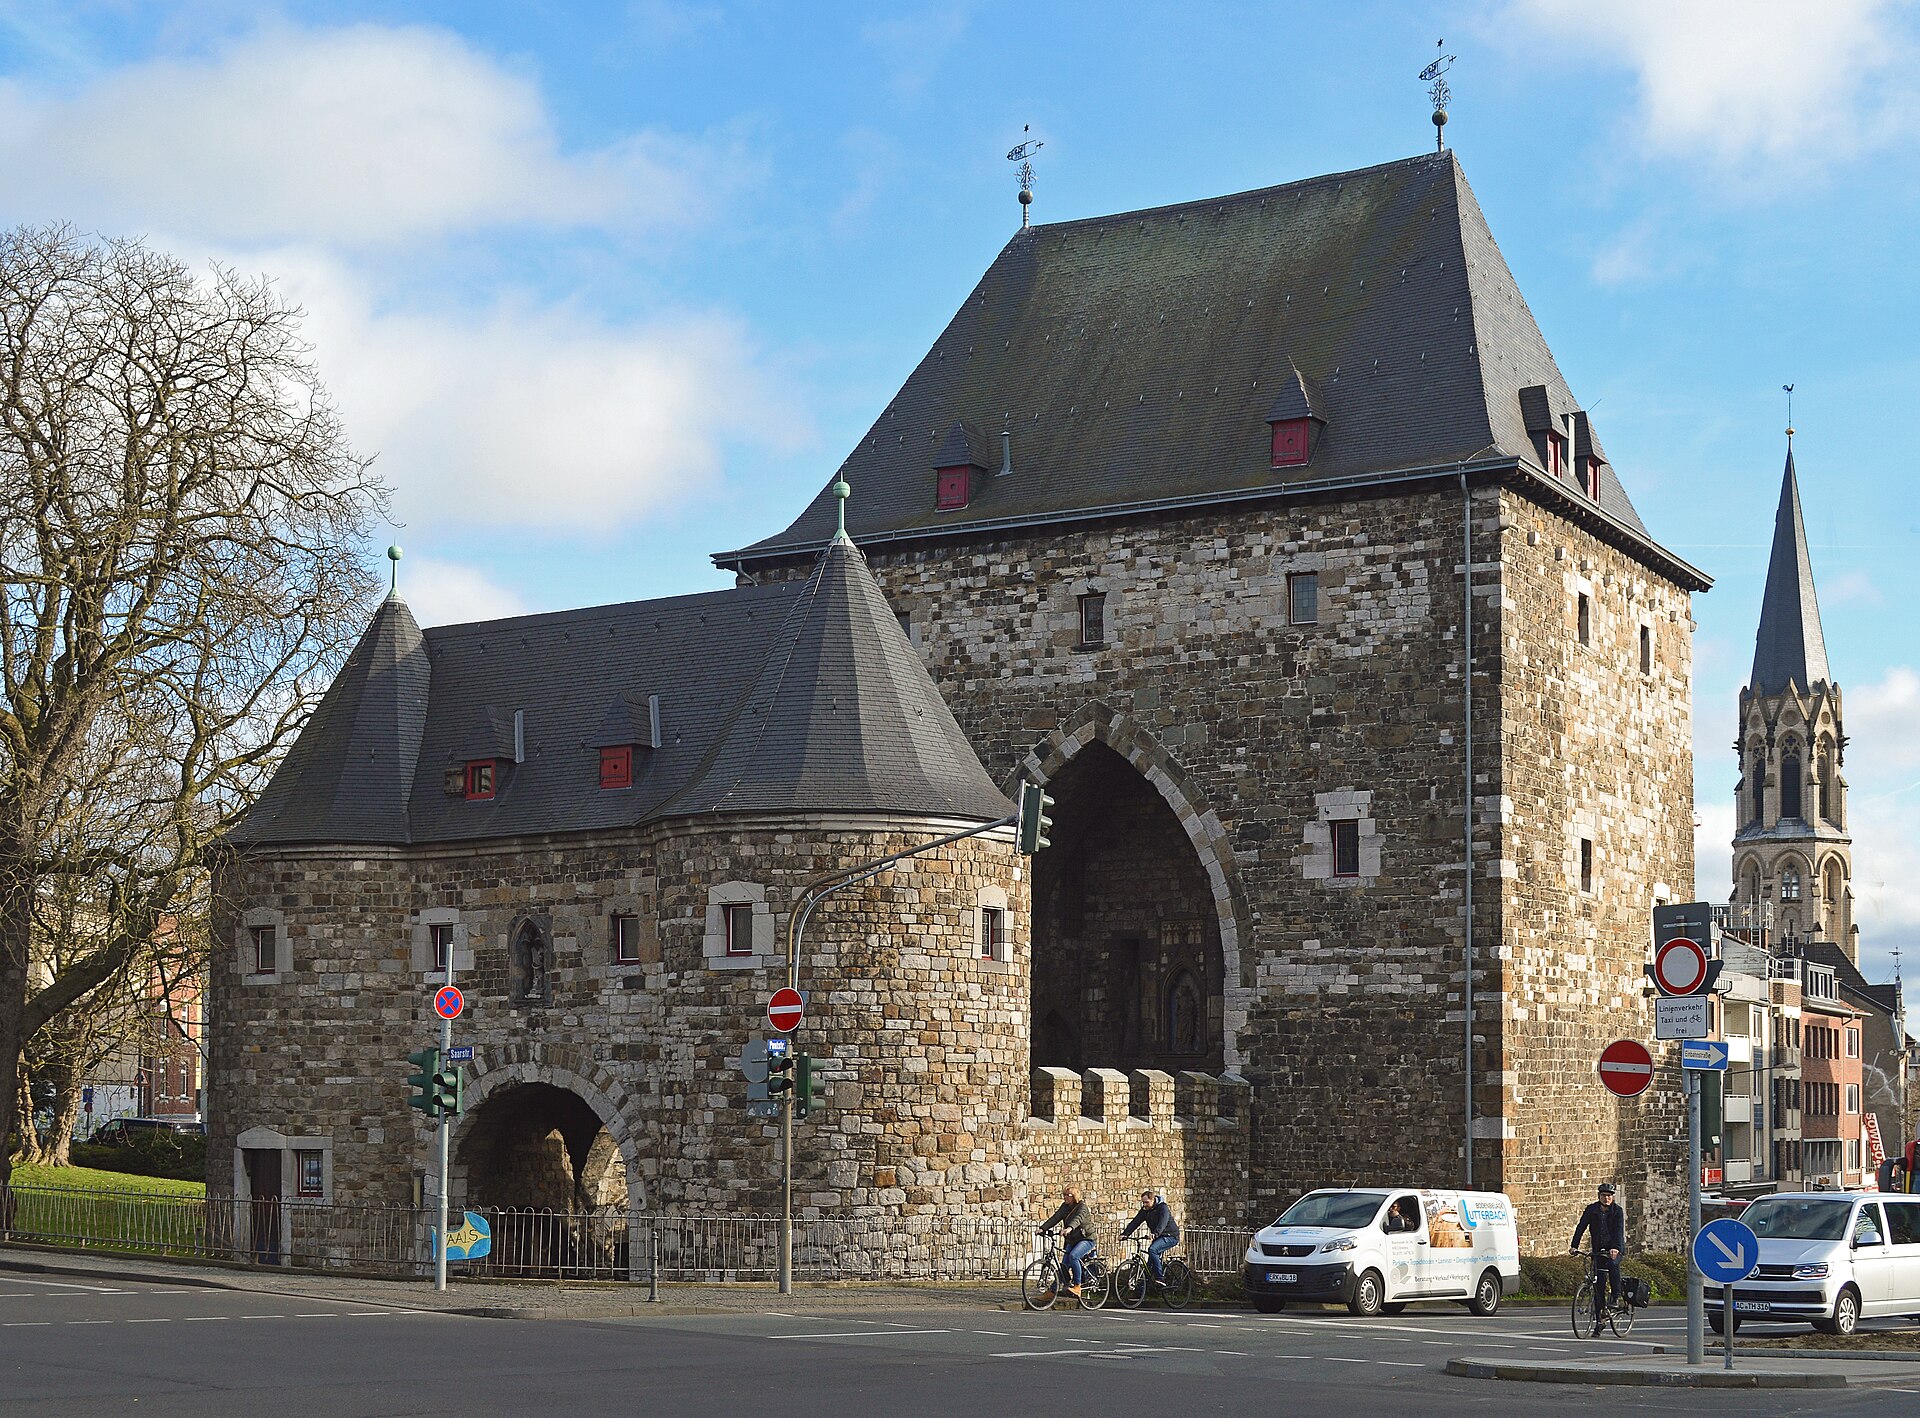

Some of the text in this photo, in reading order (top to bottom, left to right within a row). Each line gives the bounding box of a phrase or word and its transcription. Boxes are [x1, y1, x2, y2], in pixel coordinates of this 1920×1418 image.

[1659, 1004, 1703, 1013] Linienverkehr
[451, 1049, 472, 1059] Saarstr.
[446, 1229, 479, 1246] AALS
